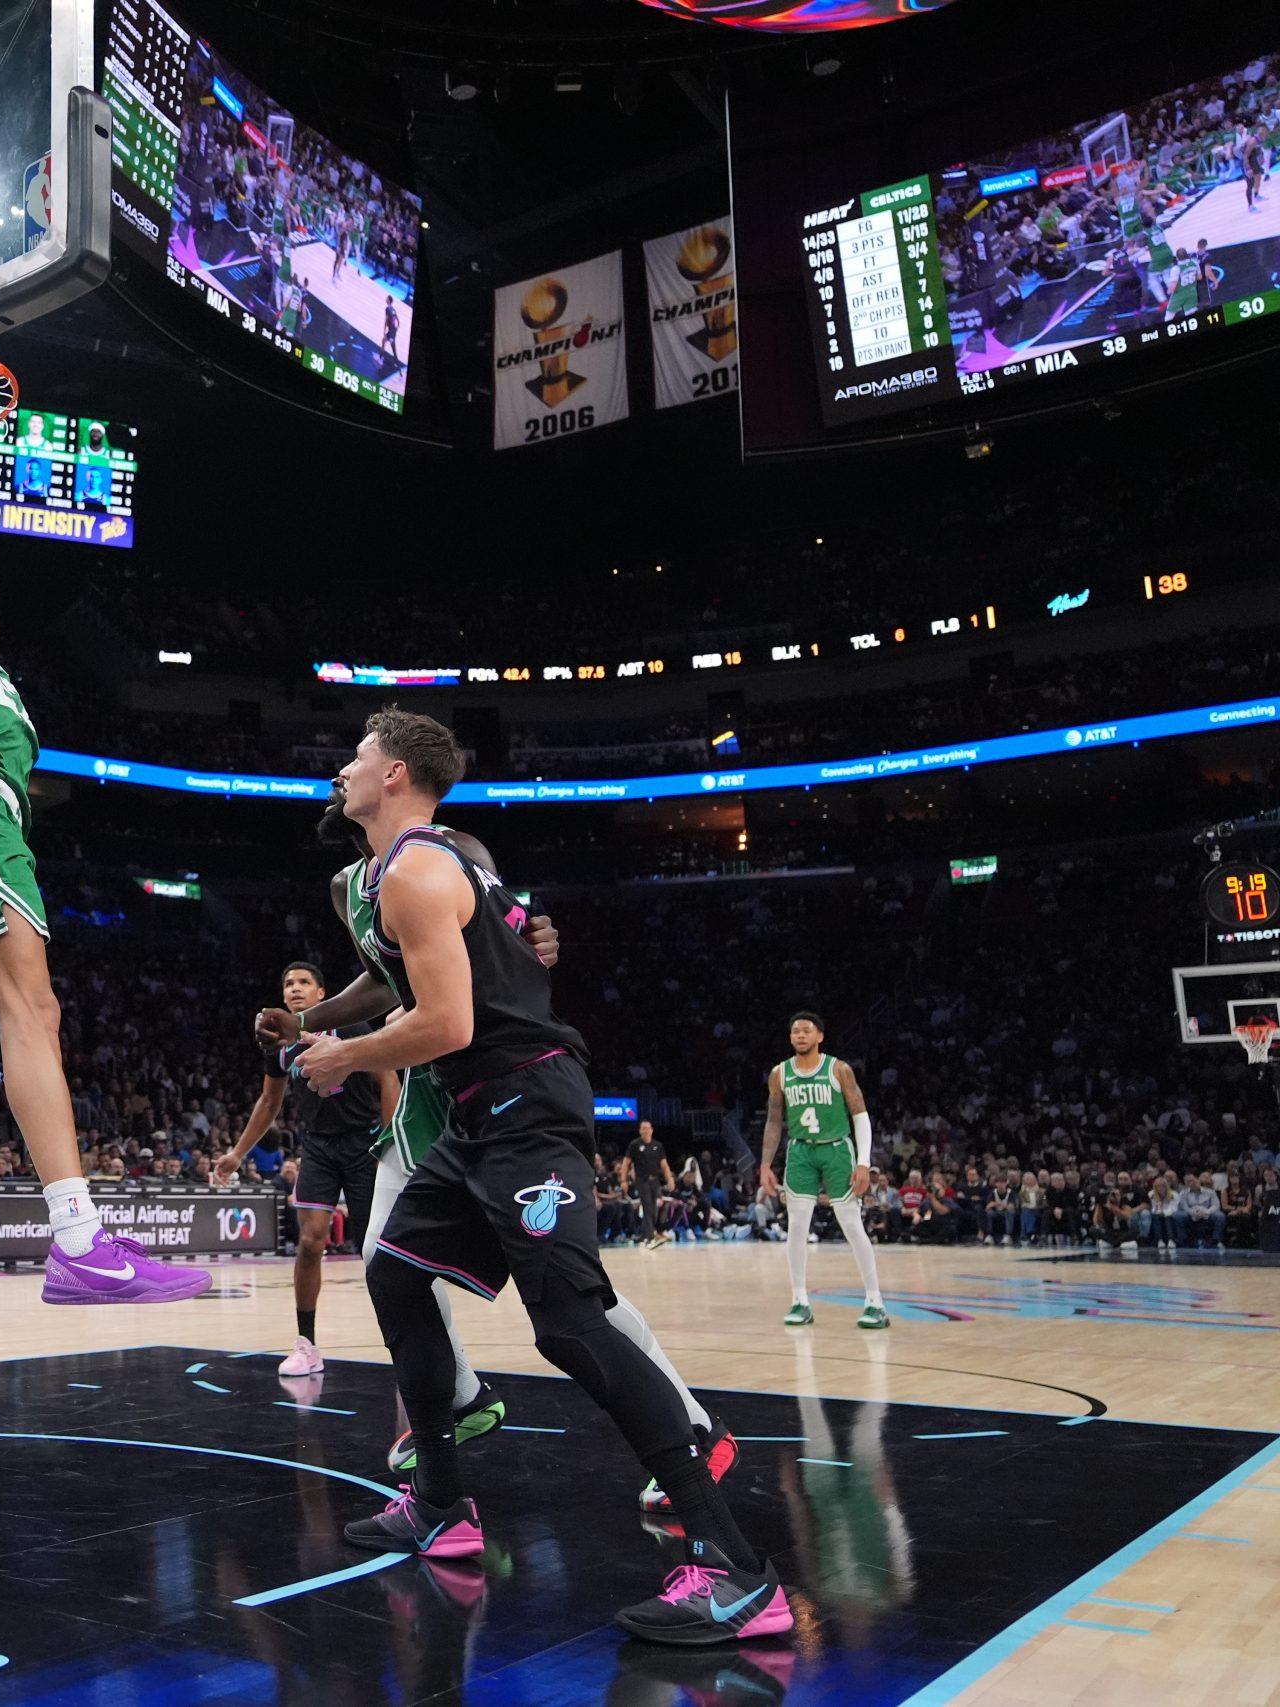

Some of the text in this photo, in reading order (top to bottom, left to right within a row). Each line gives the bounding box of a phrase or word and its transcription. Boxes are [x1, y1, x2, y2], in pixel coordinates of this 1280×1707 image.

[870, 184, 922, 208] CELTICS
[802, 203, 929, 251] 14/33 FG 11/28
[803, 199, 855, 229] HEAT
[852, 242, 859, 254] 3
[862, 235, 884, 252] PTS
[902, 222, 929, 242] 5/15
[863, 256, 877, 269] FT
[907, 241, 929, 259] 3/4
[818, 260, 924, 301] 10 AST 7
[824, 278, 927, 318] 7 OFF REB 7
[885, 304, 903, 319] PTS
[918, 296, 934, 312] 14
[207, 286, 230, 318] MIA
[242, 312, 256, 333] 38
[274, 334, 292, 353] 9:19
[310, 353, 325, 373] 30
[333, 366, 359, 393] BOS
[829, 338, 839, 354] 2
[874, 326, 888, 341] TO
[857, 331, 938, 363] PTS IN PAINT 10
[1034, 349, 1079, 375] MIA
[1102, 336, 1128, 357] 38
[1141, 329, 1159, 343] 2nd
[1167, 318, 1198, 337] 9:19
[1207, 313, 1219, 324] 11
[1238, 297, 1265, 318] 30
[834, 366, 938, 402] AROMA360
[961, 382, 986, 395] TOL:
[524, 405, 595, 442] 2006
[3, 504, 97, 539] INTENSITY
[1158, 572, 1187, 595] 38
[617, 661, 645, 676] AST
[648, 660, 663, 674] 10
[693, 653, 721, 669] REB
[725, 651, 741, 666] 15
[772, 643, 801, 660] BLK
[811, 642, 818, 656] 1
[851, 634, 880, 650] TOL
[931, 618, 960, 635] FLS
[971, 614, 978, 628] 1
[822, 765, 874, 777] Connecting
[1086, 727, 1116, 741] AT&T
[1210, 706, 1275, 722] Connecting
[1226, 873, 1267, 894] 9:19
[1236, 890, 1268, 922] 10
[1236, 929, 1280, 942] TISSOT
[783, 1083, 833, 1107] BOSTON
[800, 1107, 821, 1133] 4
[100, 1204, 196, 1224] fficial Airline of
[159, 1227, 192, 1245] HEAT
